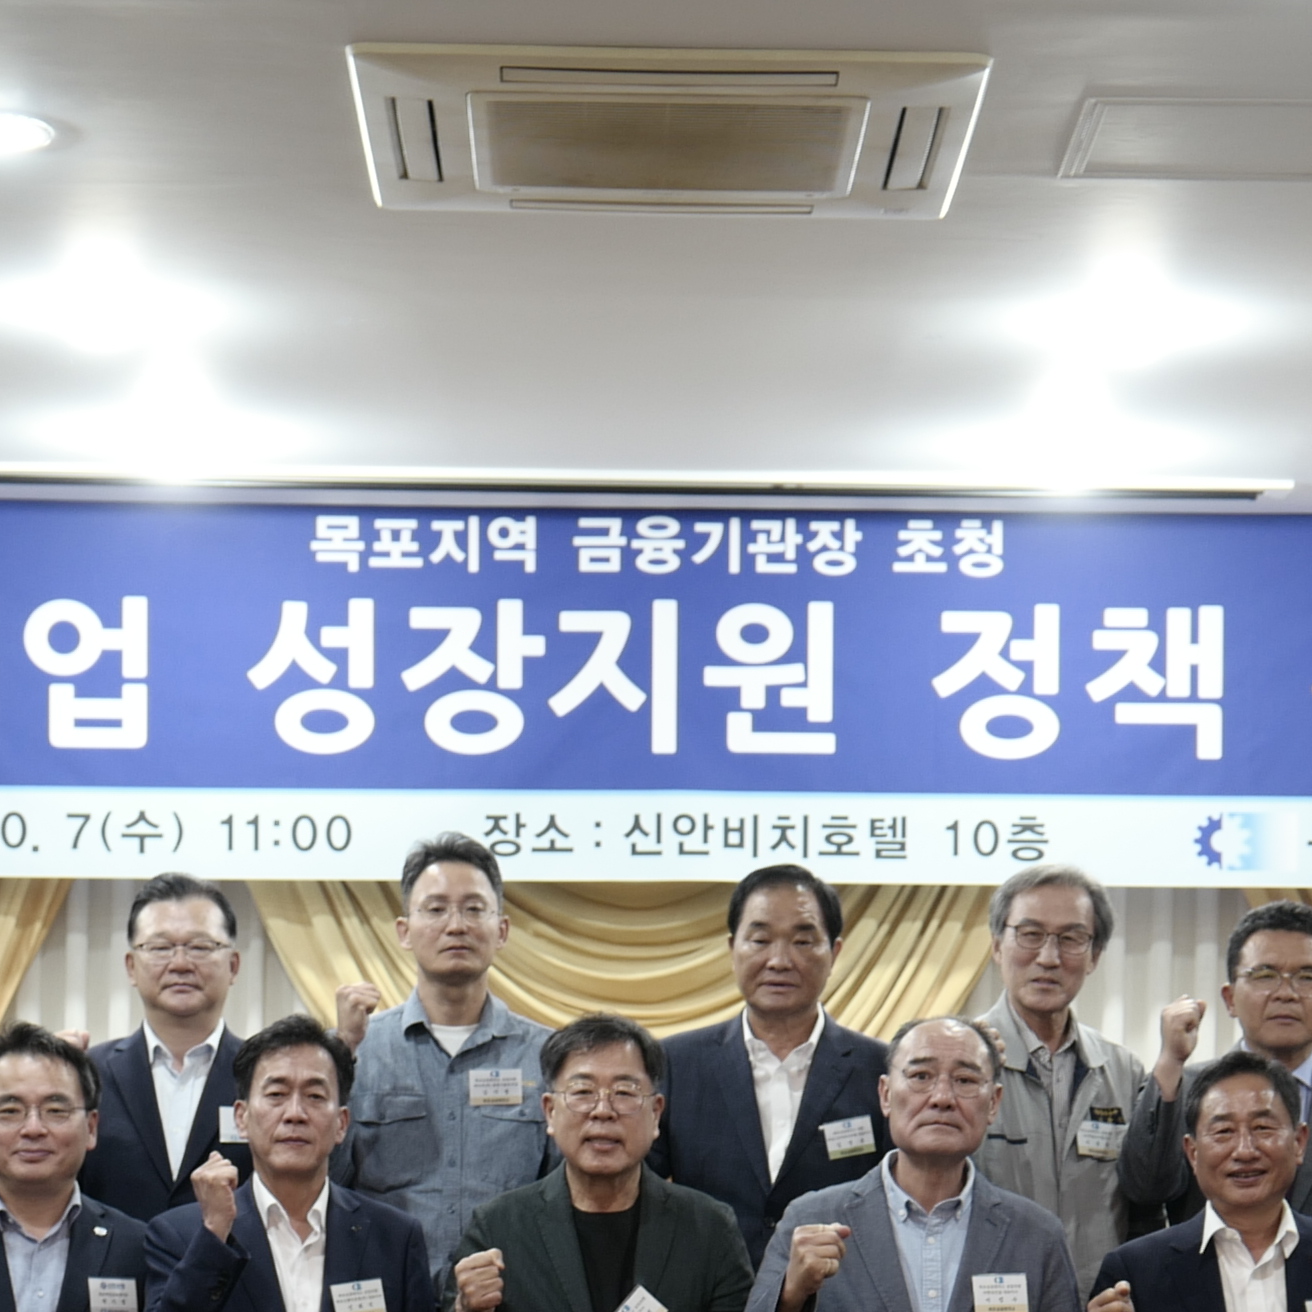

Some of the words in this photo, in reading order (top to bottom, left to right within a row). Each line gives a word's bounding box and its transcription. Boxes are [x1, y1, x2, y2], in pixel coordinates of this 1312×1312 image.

[309, 515, 538, 574] 목포지역
[571, 517, 864, 577] 금융기관장
[891, 519, 1005, 579] 초청
[245, 597, 837, 756] 성장지원
[930, 602, 1225, 761] 정책
[66, 810, 184, 854] 7(수)
[220, 814, 353, 852] 11:00
[623, 812, 908, 859] 신안비치호텔
[945, 815, 1049, 862] 10층
